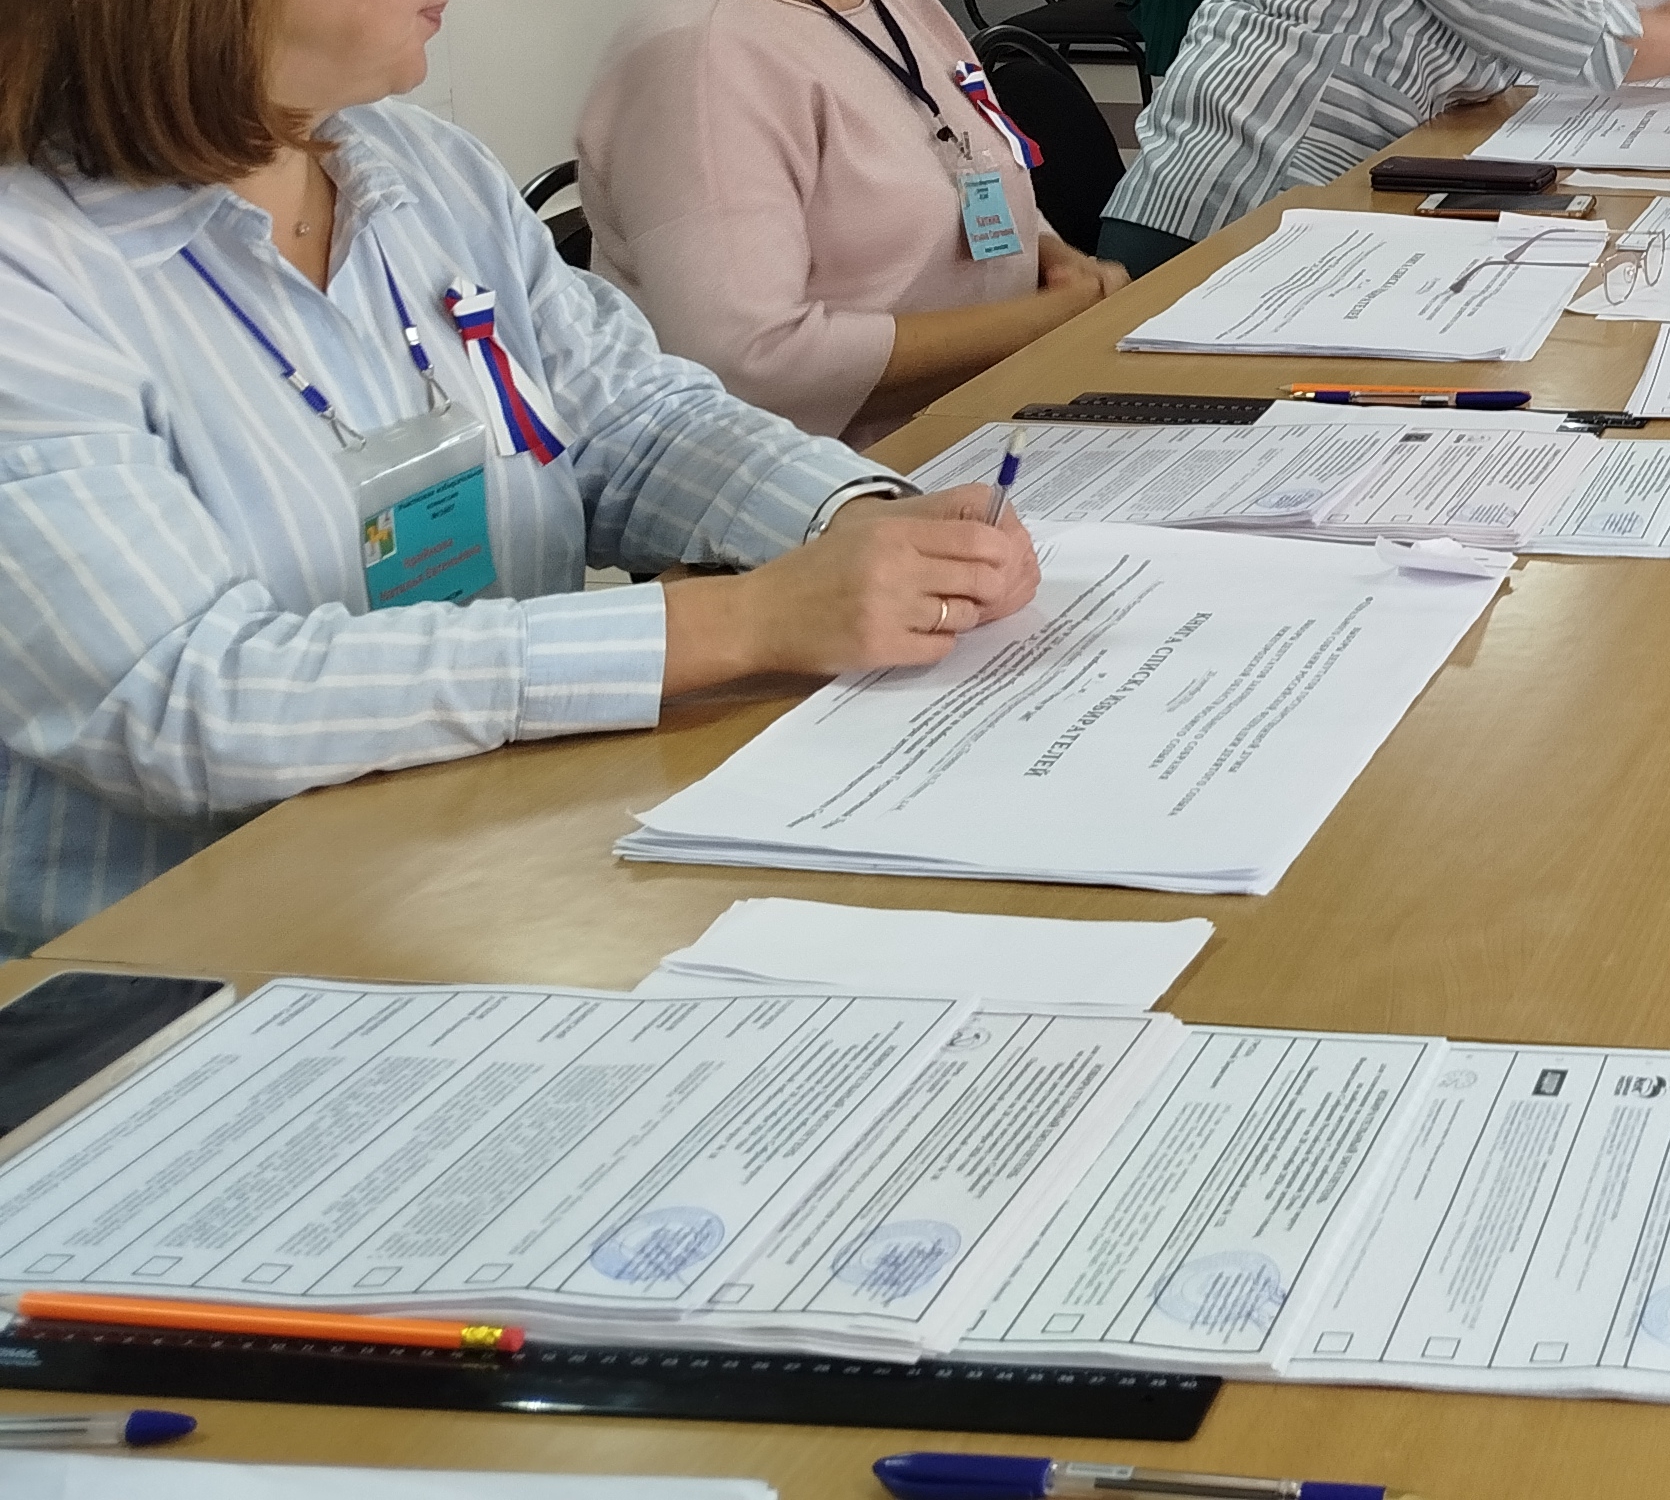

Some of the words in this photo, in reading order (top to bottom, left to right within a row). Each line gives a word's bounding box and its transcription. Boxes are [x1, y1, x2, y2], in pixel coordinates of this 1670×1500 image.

[1164, 612, 1213, 645] КНИГА
[1115, 646, 1174, 693] СПИСКА
[1023, 694, 1127, 778] ИЗБИРАТЕЛЕЙ
